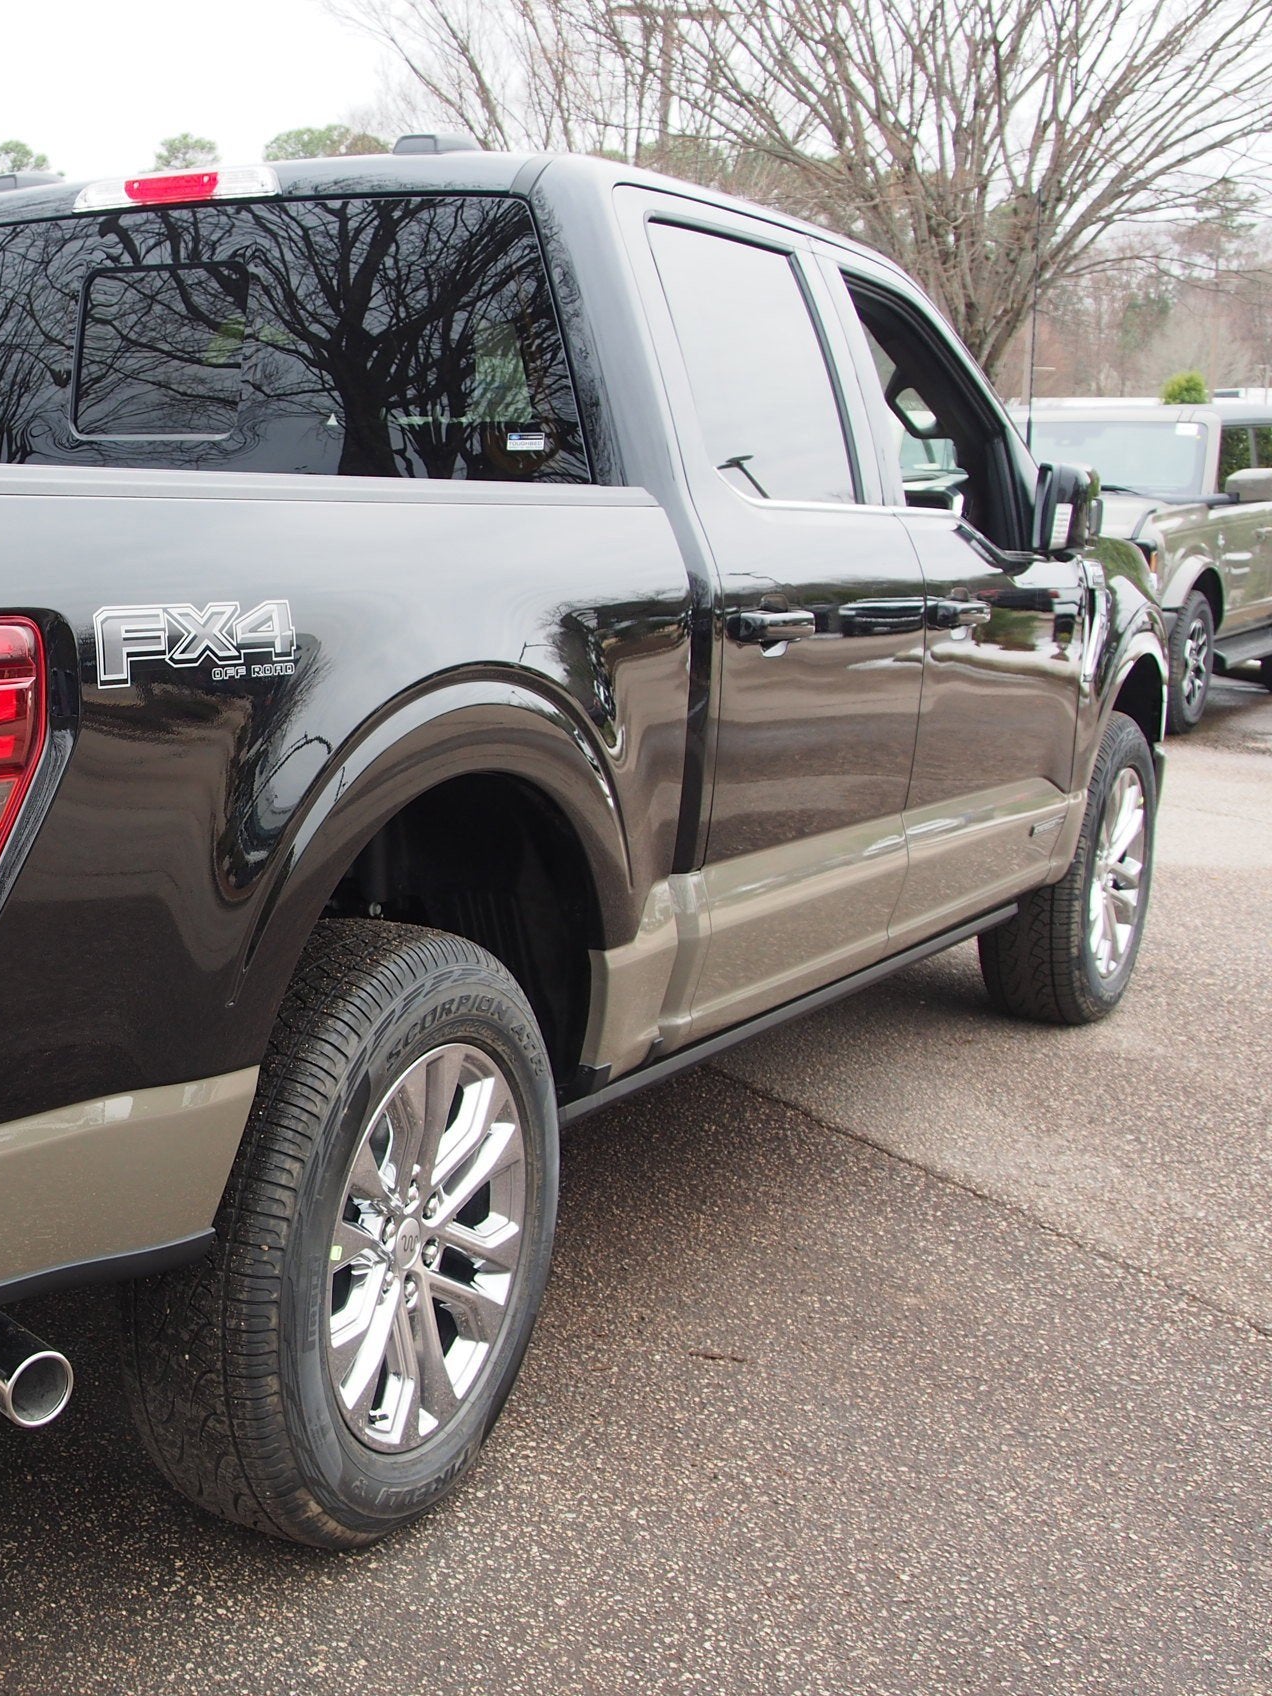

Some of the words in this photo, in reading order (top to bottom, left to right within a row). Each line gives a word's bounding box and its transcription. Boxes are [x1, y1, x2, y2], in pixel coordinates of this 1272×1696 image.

[93, 599, 296, 689] FX4
[211, 666, 247, 681] OFF
[251, 662, 295, 677] ROAD
[386, 994, 511, 1072] SCORPION
